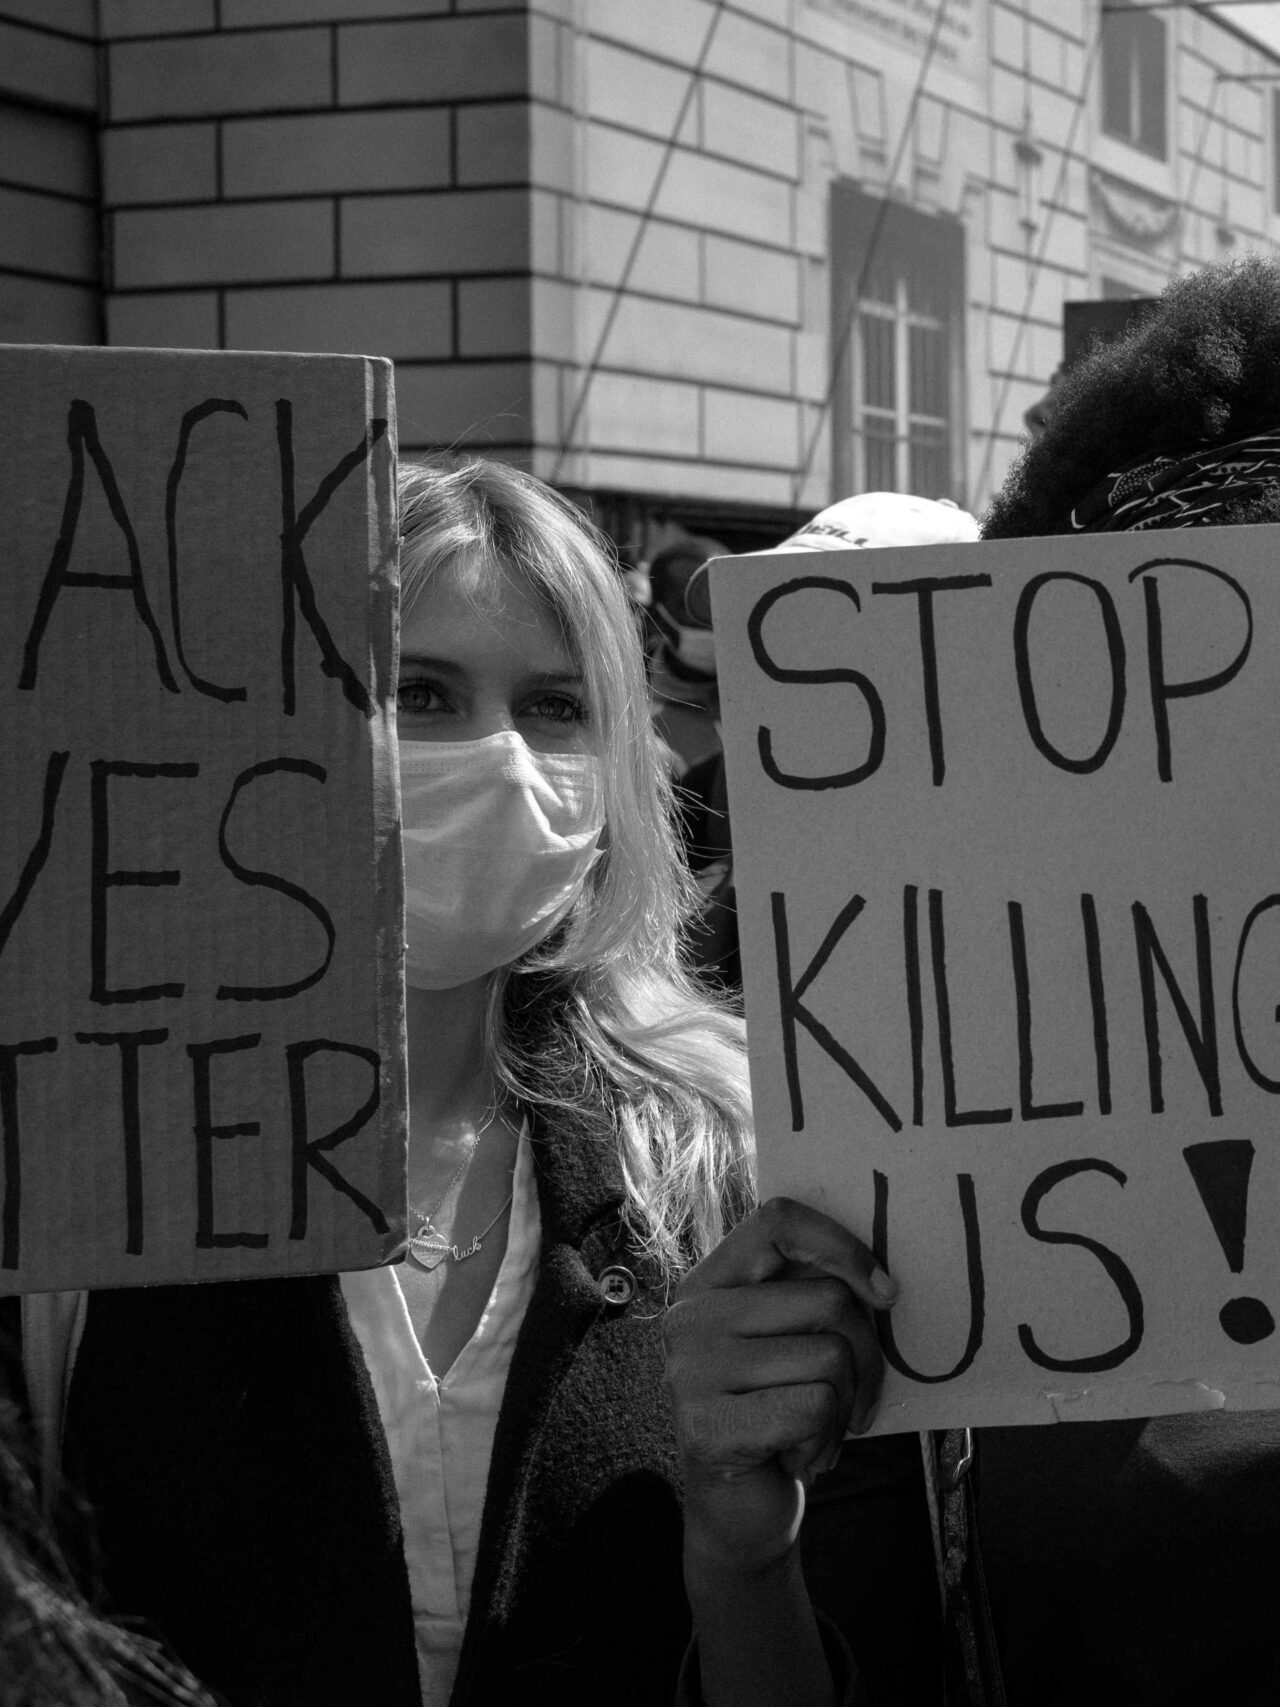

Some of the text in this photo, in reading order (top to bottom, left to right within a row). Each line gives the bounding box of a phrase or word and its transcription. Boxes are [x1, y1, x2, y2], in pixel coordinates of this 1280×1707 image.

[18, 399, 388, 716] ACK
[746, 557, 1254, 791] STOP
[0, 1028, 390, 1271] TTER
[868, 1139, 1276, 1384] US!
